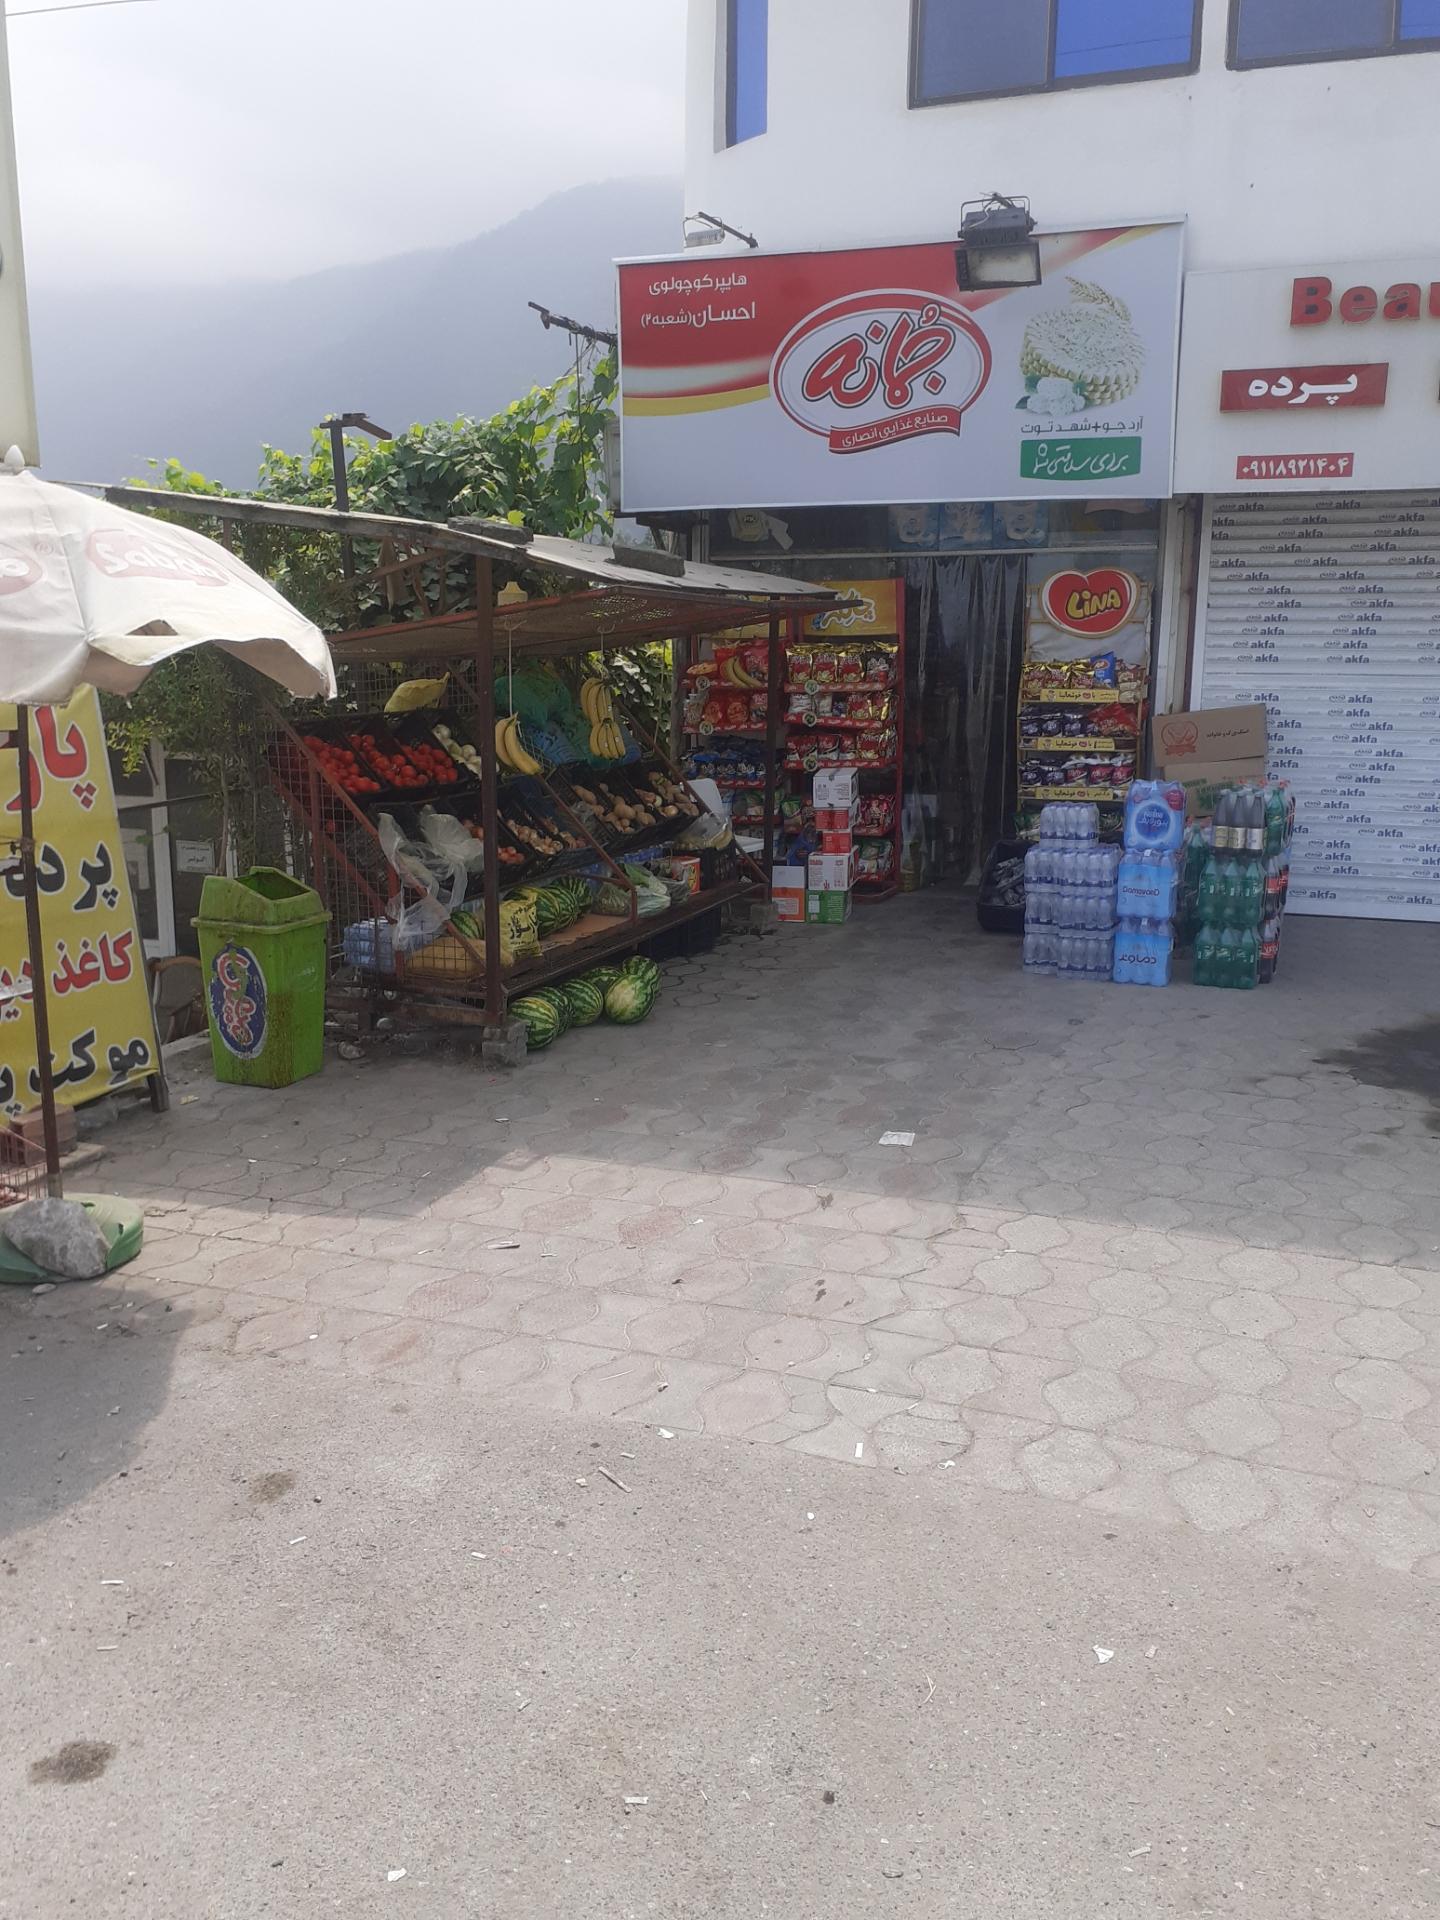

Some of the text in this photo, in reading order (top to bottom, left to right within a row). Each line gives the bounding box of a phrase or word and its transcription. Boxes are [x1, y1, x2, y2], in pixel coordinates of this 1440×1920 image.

[693, 301, 756, 327] احسان
[1248, 374, 1358, 405] پرده
[842, 412, 948, 447] صنایع غذایی انصاری
[1021, 420, 1053, 435] توت
[1090, 453, 1129, 474] برای
[1237, 502, 1265, 512] akfa
[1335, 500, 1361, 510] akfa
[1301, 515, 1328, 525] akfa
[1398, 512, 1425, 522] akfa
[1297, 528, 1324, 539] akfa
[1393, 527, 1420, 537] akfa
[1276, 543, 1302, 553] akfa
[1369, 541, 1397, 551] akfa
[1220, 558, 1246, 568] akfa
[1311, 557, 1338, 567] akfa
[1407, 555, 1436, 565] akfa
[1244, 571, 1270, 582] akfa
[1338, 570, 1365, 580] akfa
[1266, 585, 1292, 595] akfa
[1357, 584, 1384, 594] akfa
[1276, 599, 1302, 609] akfa
[1368, 599, 1395, 609] akfa
[1263, 613, 1289, 623] akfa
[1355, 612, 1383, 623] akfa
[1259, 626, 1285, 636] akfa
[1351, 626, 1377, 636] akfa
[1250, 639, 1276, 650] akfa
[1342, 640, 1368, 650] akfa
[1254, 653, 1279, 663] akfa
[1344, 654, 1370, 664] akfa
[1253, 692, 1280, 702] akfa
[1347, 694, 1373, 704] akfa
[1345, 708, 1371, 719] akfa
[1276, 719, 1302, 729] akfa
[1368, 721, 1394, 731] akfa
[1351, 734, 1378, 744] akfa
[1276, 745, 1304, 756] akfa
[1375, 748, 1403, 758] akfa
[1271, 759, 1299, 769] akfa
[1368, 761, 1395, 772] akfa
[1354, 775, 1381, 785] akfa
[1339, 787, 1366, 798] akfa
[1323, 800, 1351, 810] akfa
[1345, 814, 1372, 824] akfa
[1377, 828, 1404, 839] akfa
[1325, 839, 1351, 850] akfa
[1324, 852, 1352, 862] akfa
[1332, 865, 1360, 876] akfa
[1309, 889, 1337, 900] akfa
[1405, 895, 1434, 905] akfa
[53, 931, 133, 993] کاغذ
[1118, 952, 1157, 965] دماوند
